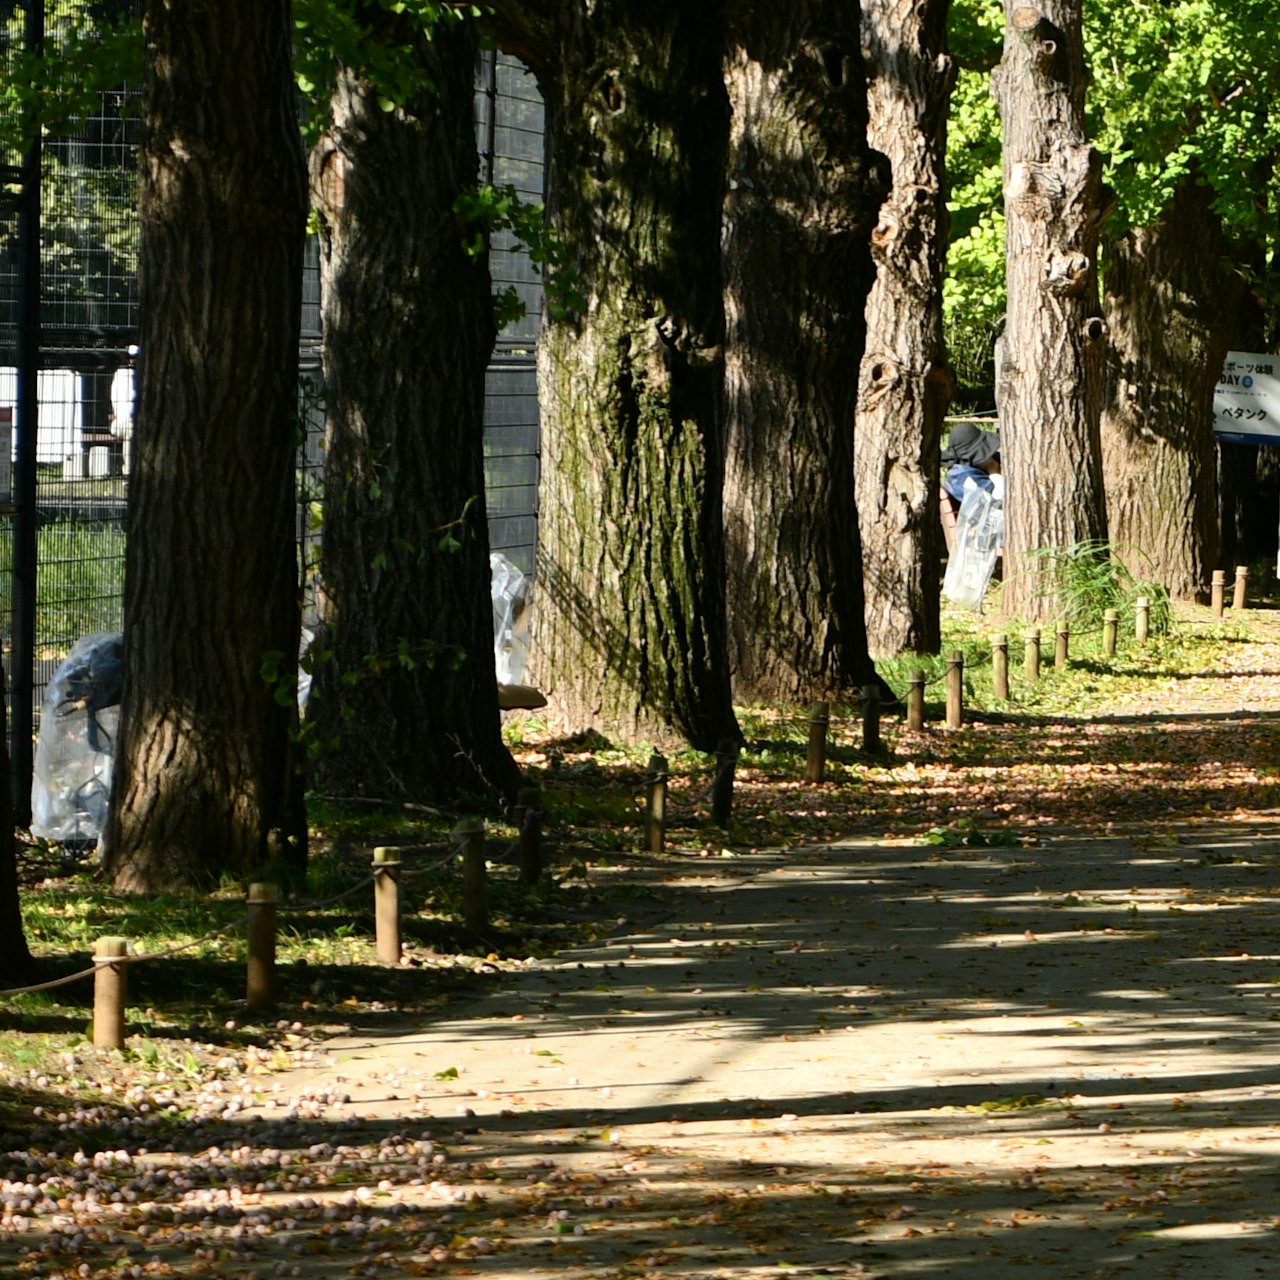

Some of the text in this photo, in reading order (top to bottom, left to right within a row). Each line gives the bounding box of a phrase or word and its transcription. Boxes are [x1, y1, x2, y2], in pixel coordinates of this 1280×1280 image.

[1220, 375, 1240, 386] DAY
[1222, 407, 1267, 421] ペタンク
